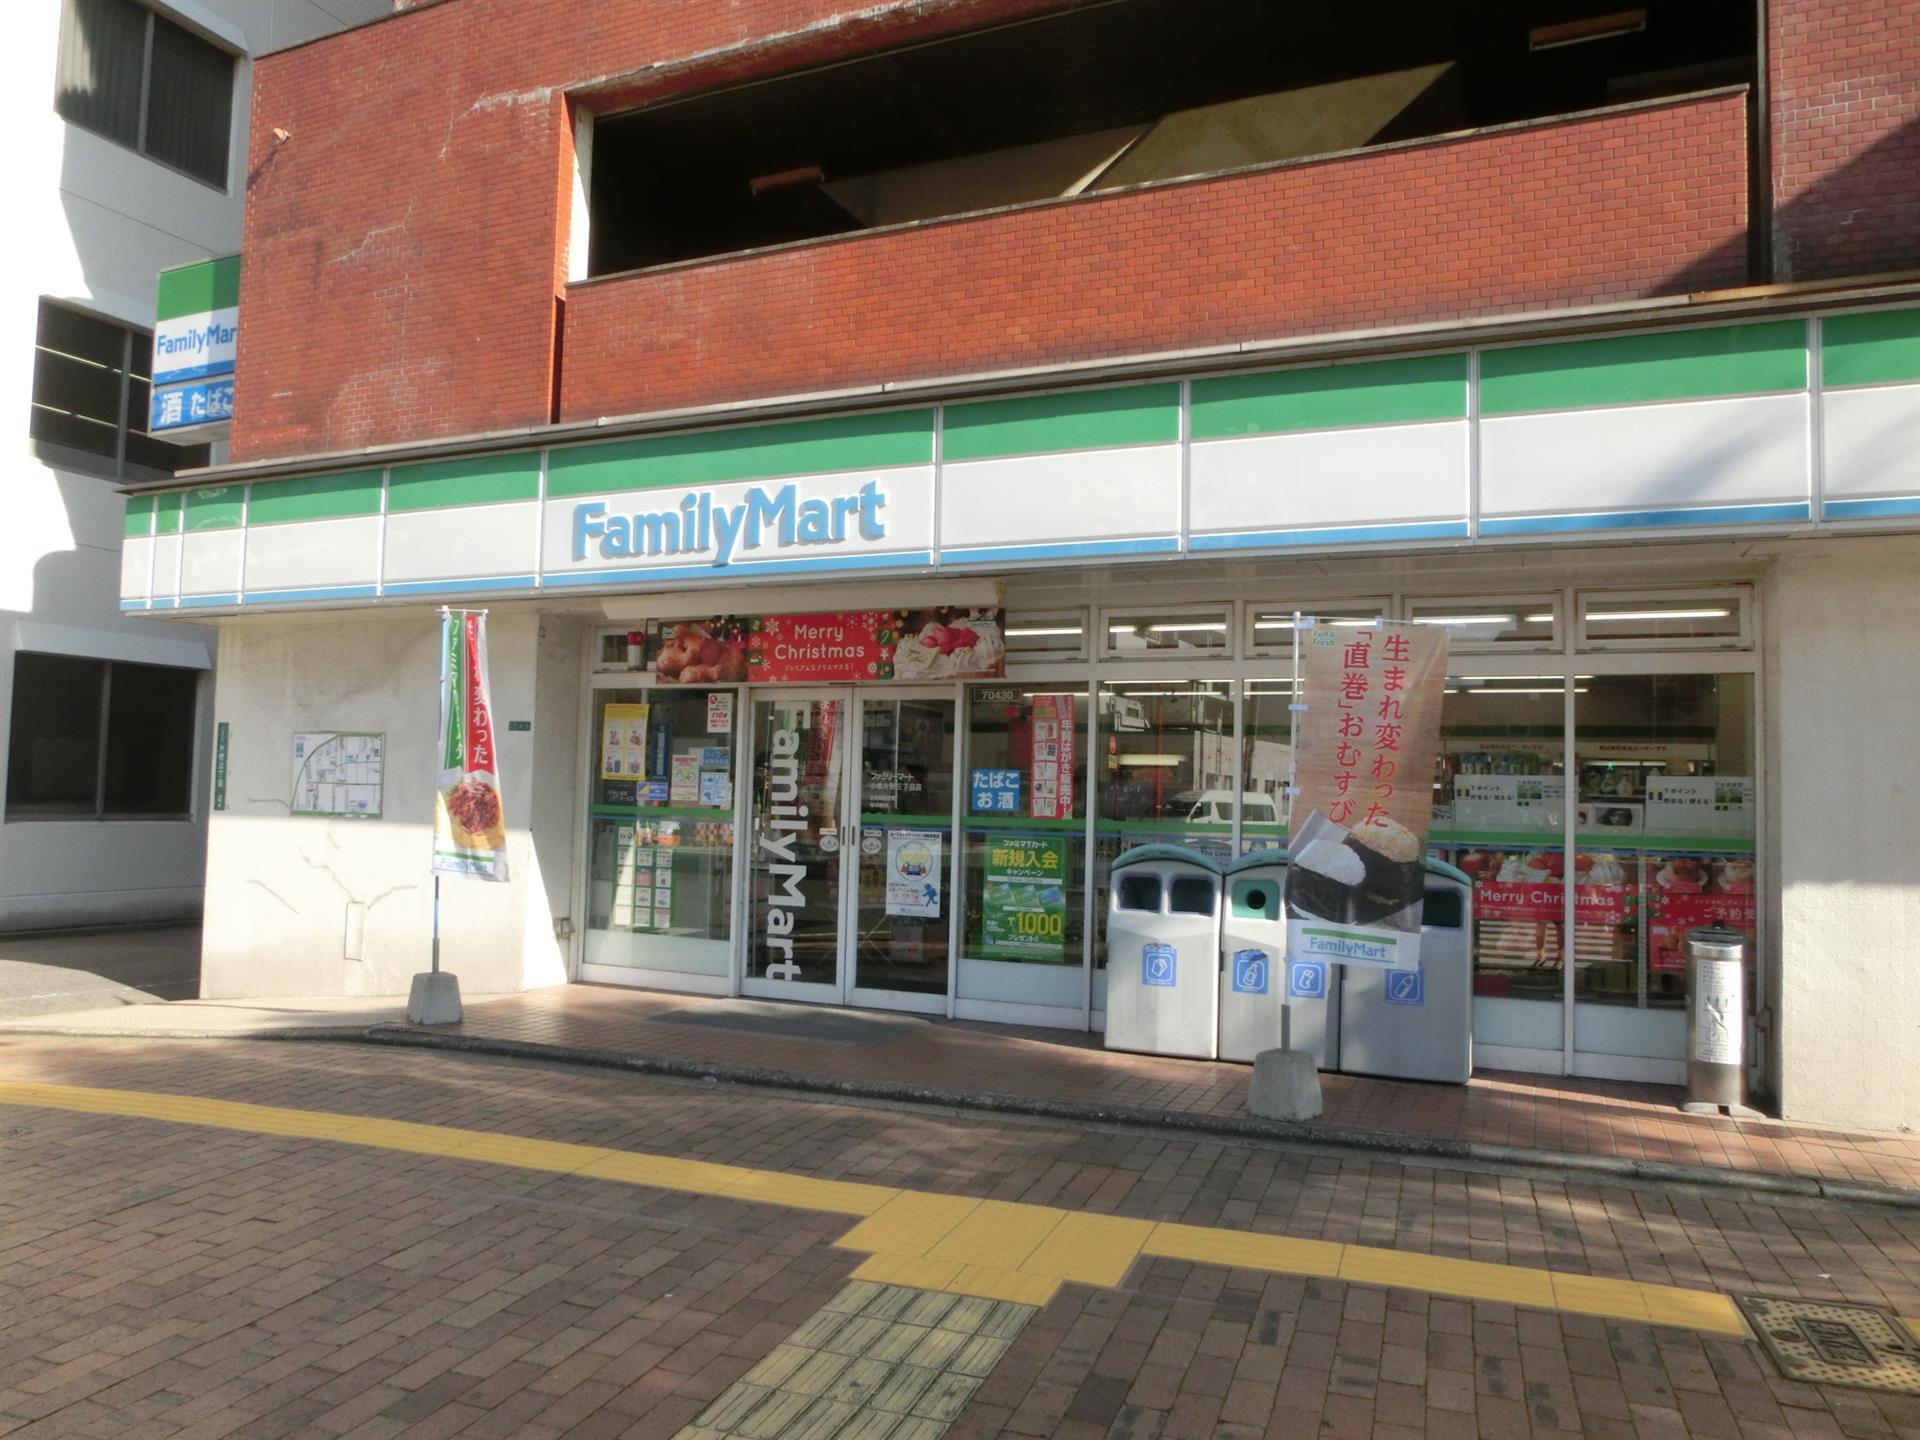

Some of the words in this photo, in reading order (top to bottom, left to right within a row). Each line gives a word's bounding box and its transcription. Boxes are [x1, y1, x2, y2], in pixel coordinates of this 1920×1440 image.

[160, 391, 184, 424] 酒
[571, 480, 888, 568] FamilyMart
[794, 624, 844, 642] Merry
[774, 643, 865, 660] Christmas
[982, 690, 1014, 700] 70430
[1328, 630, 1372, 825] 「直巻」おむすび
[1364, 634, 1411, 828] 生まれ変わった
[973, 771, 1020, 789] たばこ
[760, 702, 812, 981] FamilyMart
[991, 848, 1058, 870] 新規入会
[1006, 868, 1045, 877] キャンペーン
[1480, 889, 1525, 905] Merry
[1531, 890, 1615, 906] Chritmas
[1310, 936, 1387, 959] FamilyMart
